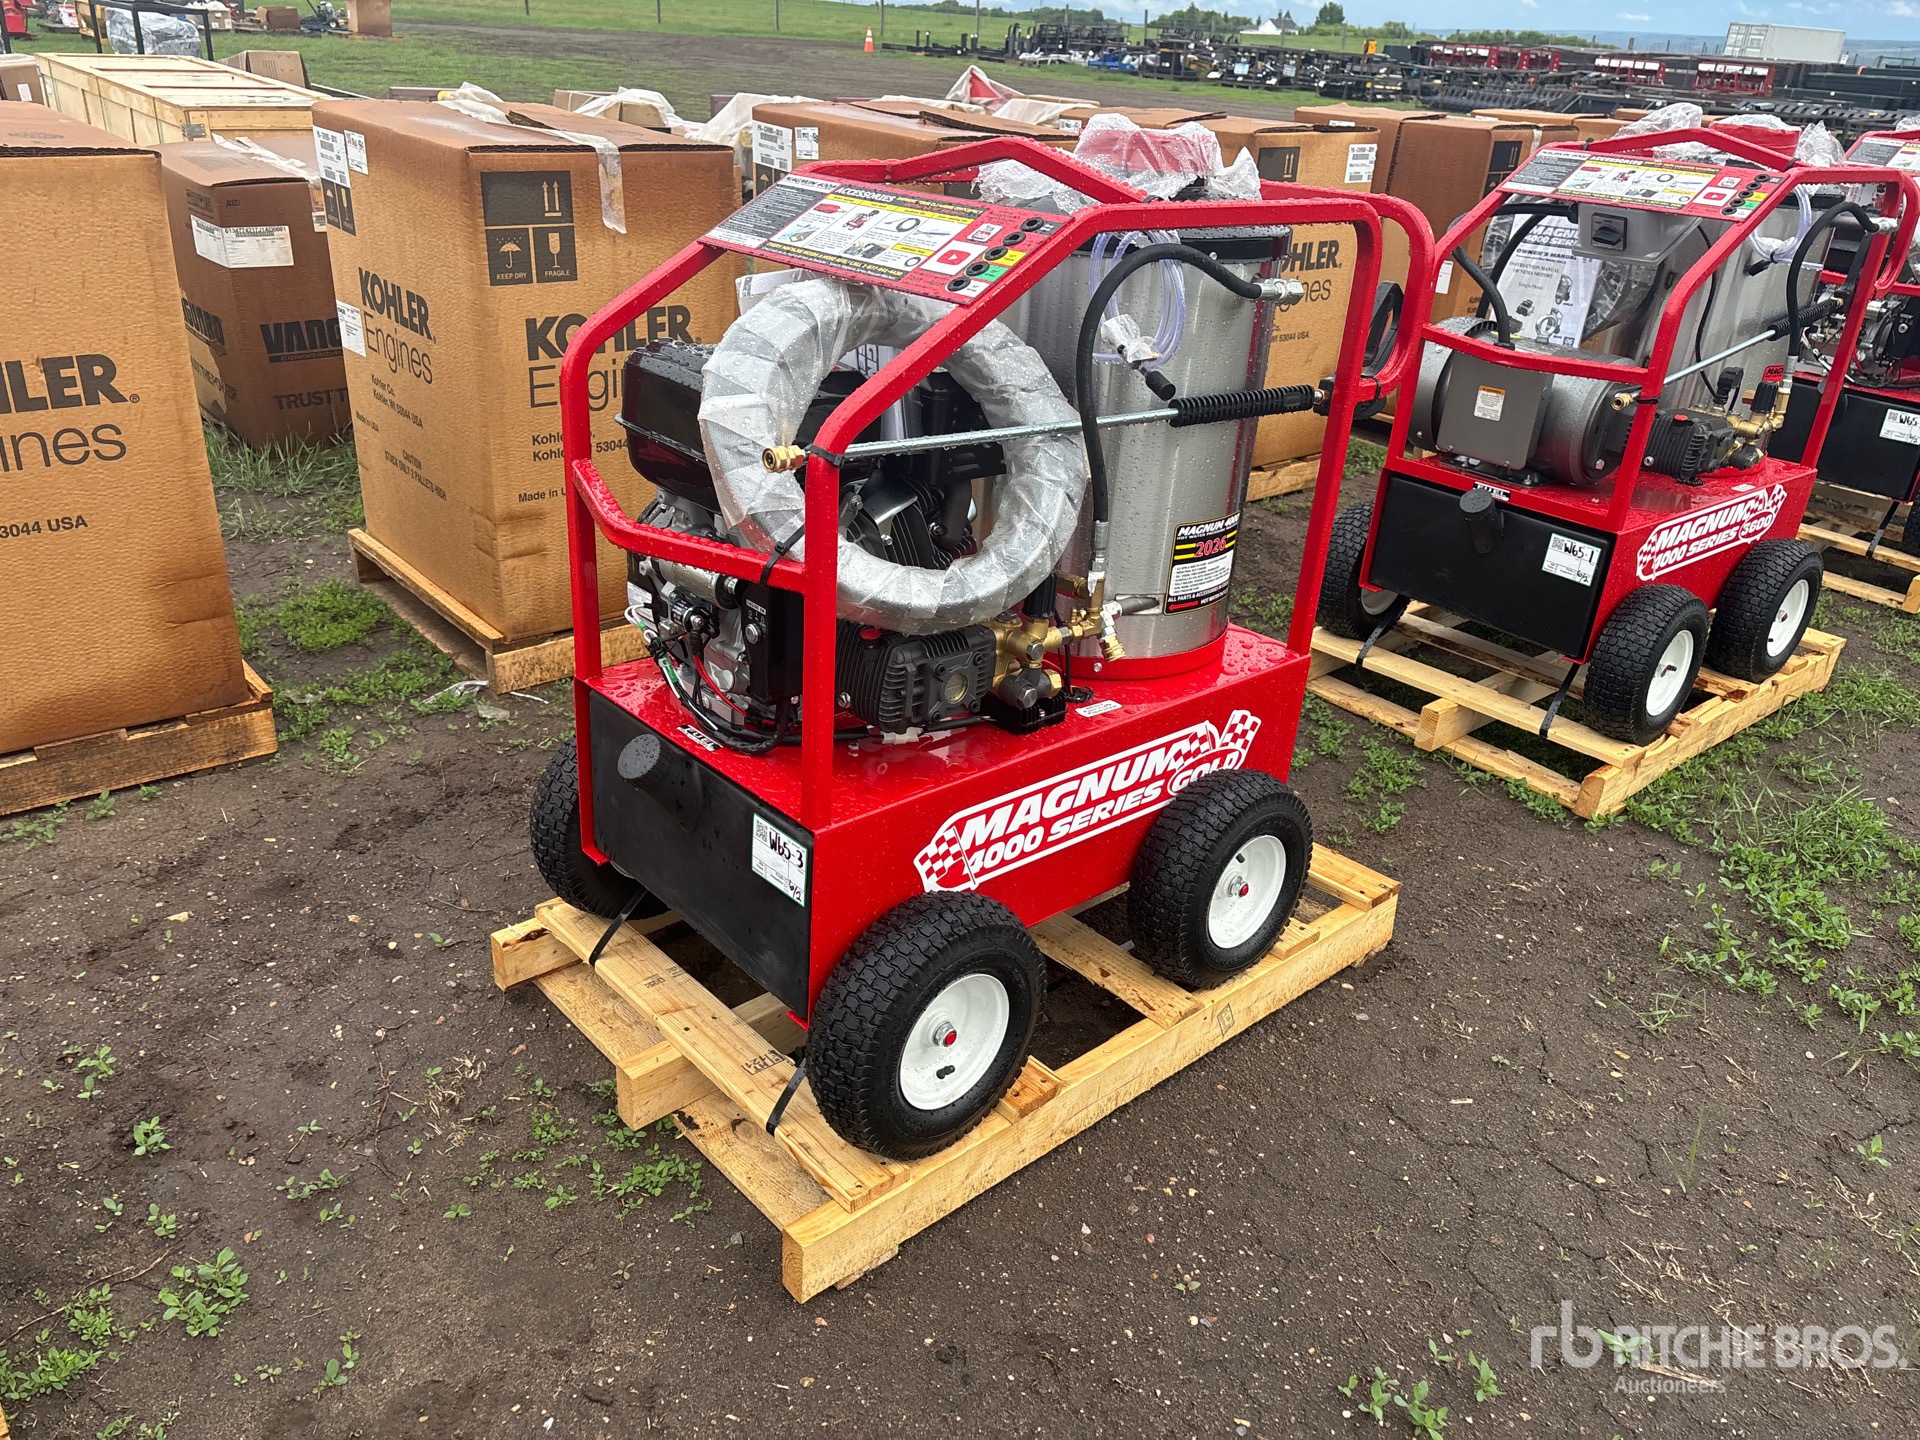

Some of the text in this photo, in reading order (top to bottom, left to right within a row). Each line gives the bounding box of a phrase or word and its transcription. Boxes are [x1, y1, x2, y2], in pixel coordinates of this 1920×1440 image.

[836, 187, 896, 203] ACCESSORIES
[515, 272, 527, 280] DRY
[545, 269, 571, 277] FRAGILE
[358, 267, 432, 340] KOHLER
[1297, 331, 1309, 339] USA
[364, 311, 433, 384] Engines
[371, 373, 386, 391] Kohler
[411, 412, 423, 429] USA
[518, 488, 558, 503] Made in
[47, 515, 88, 532] USA
[1177, 520, 1225, 536] MAGNUM
[1657, 500, 1750, 551] MAGNUM
[1195, 535, 1227, 558] 2026
[1653, 515, 1772, 569] 4000 SERIES 3600
[1563, 542, 1595, 563] W65-1
[958, 741, 1186, 846] MAGNUM
[965, 824, 1044, 874] 4000
[1047, 780, 1164, 842] SERIES
